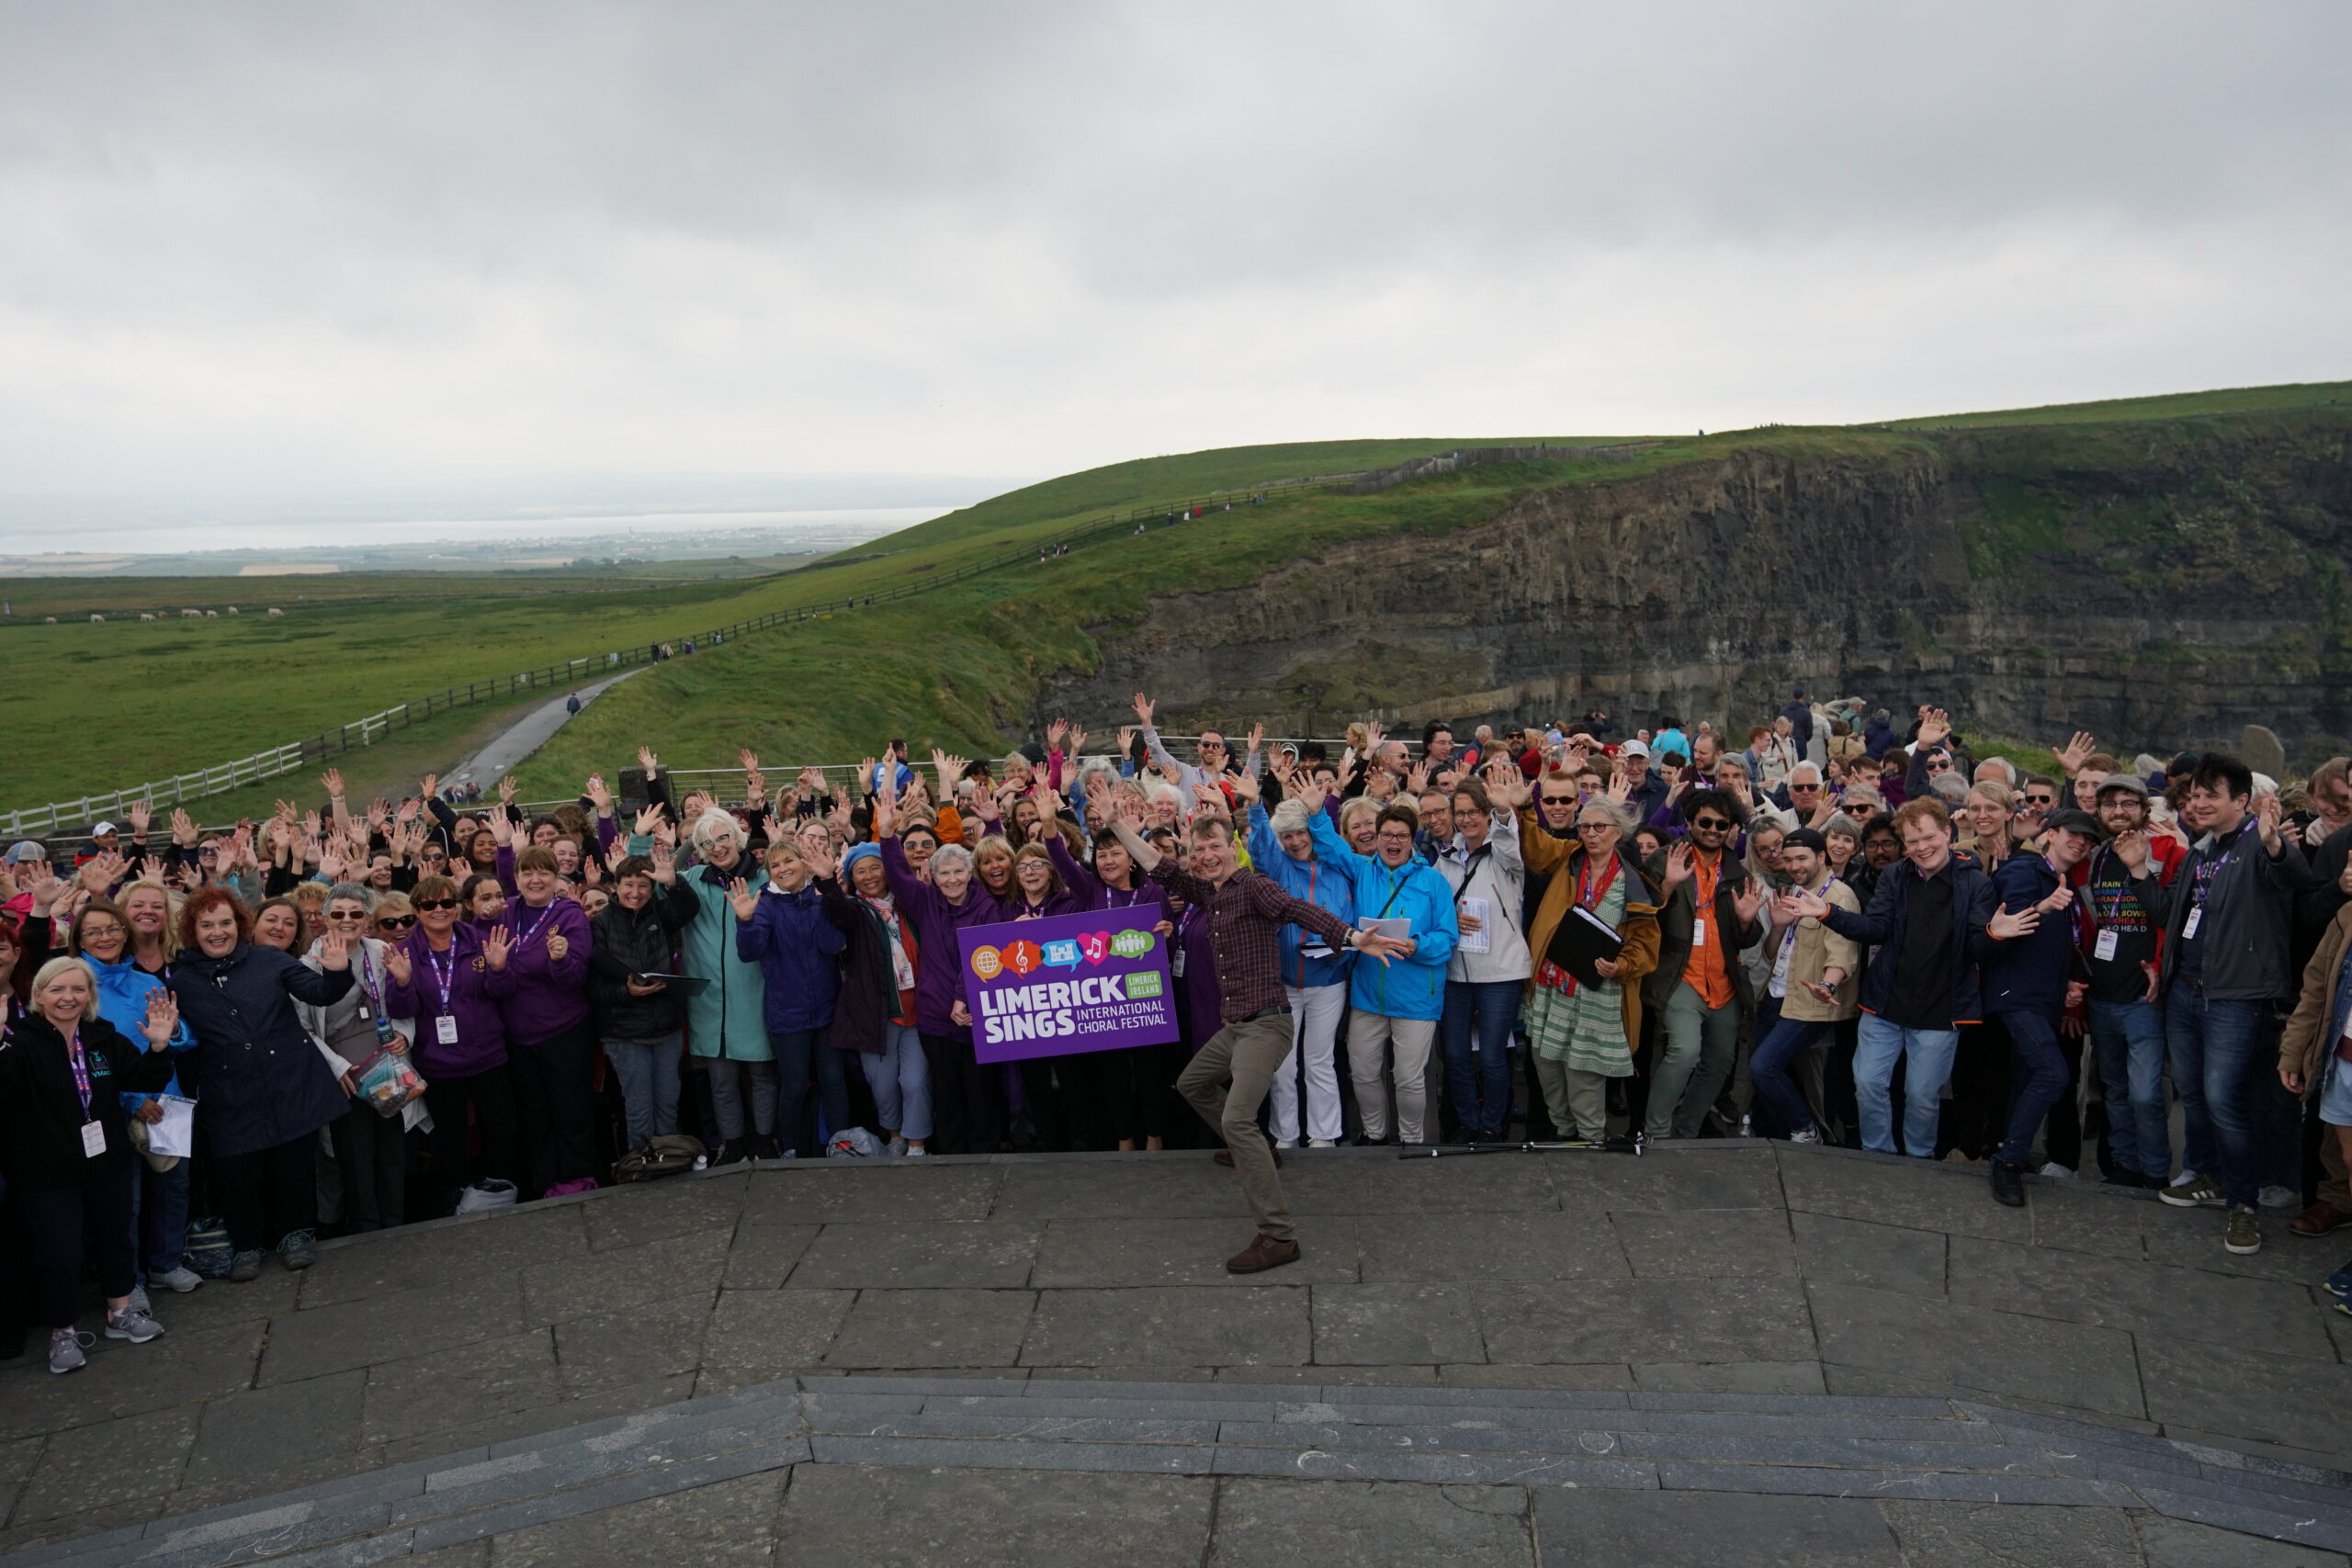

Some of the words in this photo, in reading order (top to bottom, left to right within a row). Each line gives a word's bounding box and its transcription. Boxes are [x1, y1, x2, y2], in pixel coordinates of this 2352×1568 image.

[1129, 974, 1158, 986] LIMERICK
[1130, 985, 1159, 996] IRELAND
[979, 975, 1126, 1017] LIMERICK
[1077, 1000, 1165, 1021] INTERNATIONAL
[984, 1009, 1076, 1043] SINGS
[1078, 1017, 1119, 1034] CHORAL
[1121, 1013, 1167, 1030] FESTIVAL
